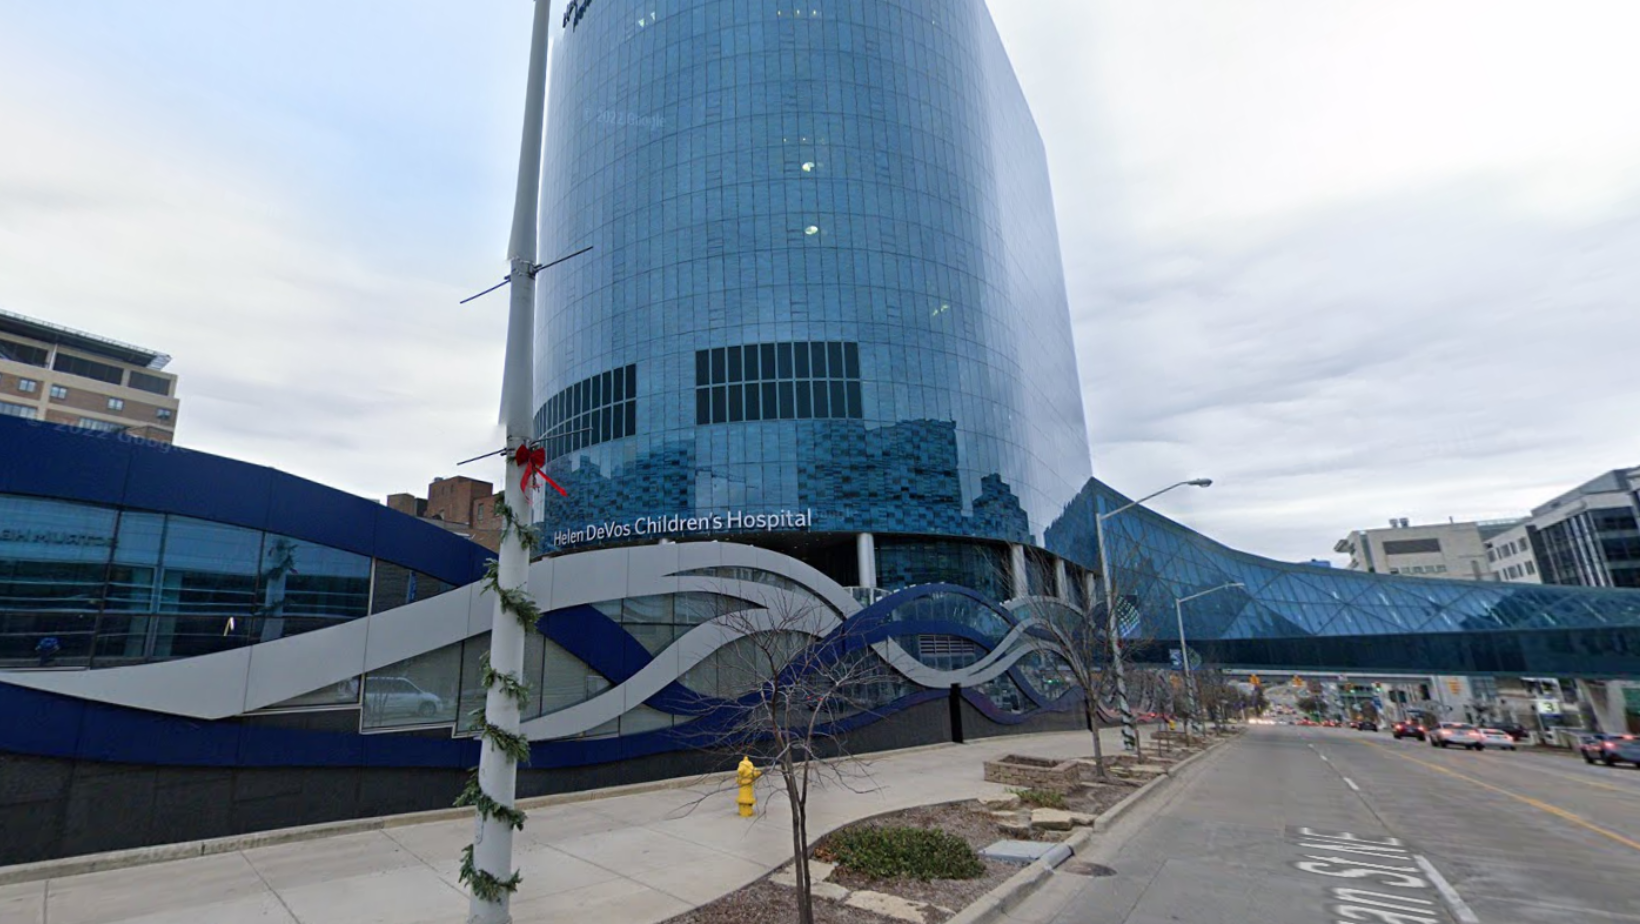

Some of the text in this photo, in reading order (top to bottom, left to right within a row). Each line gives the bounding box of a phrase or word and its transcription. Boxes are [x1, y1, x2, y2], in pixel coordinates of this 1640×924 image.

[553, 508, 812, 547] Helen DeVos Children's Hospital
